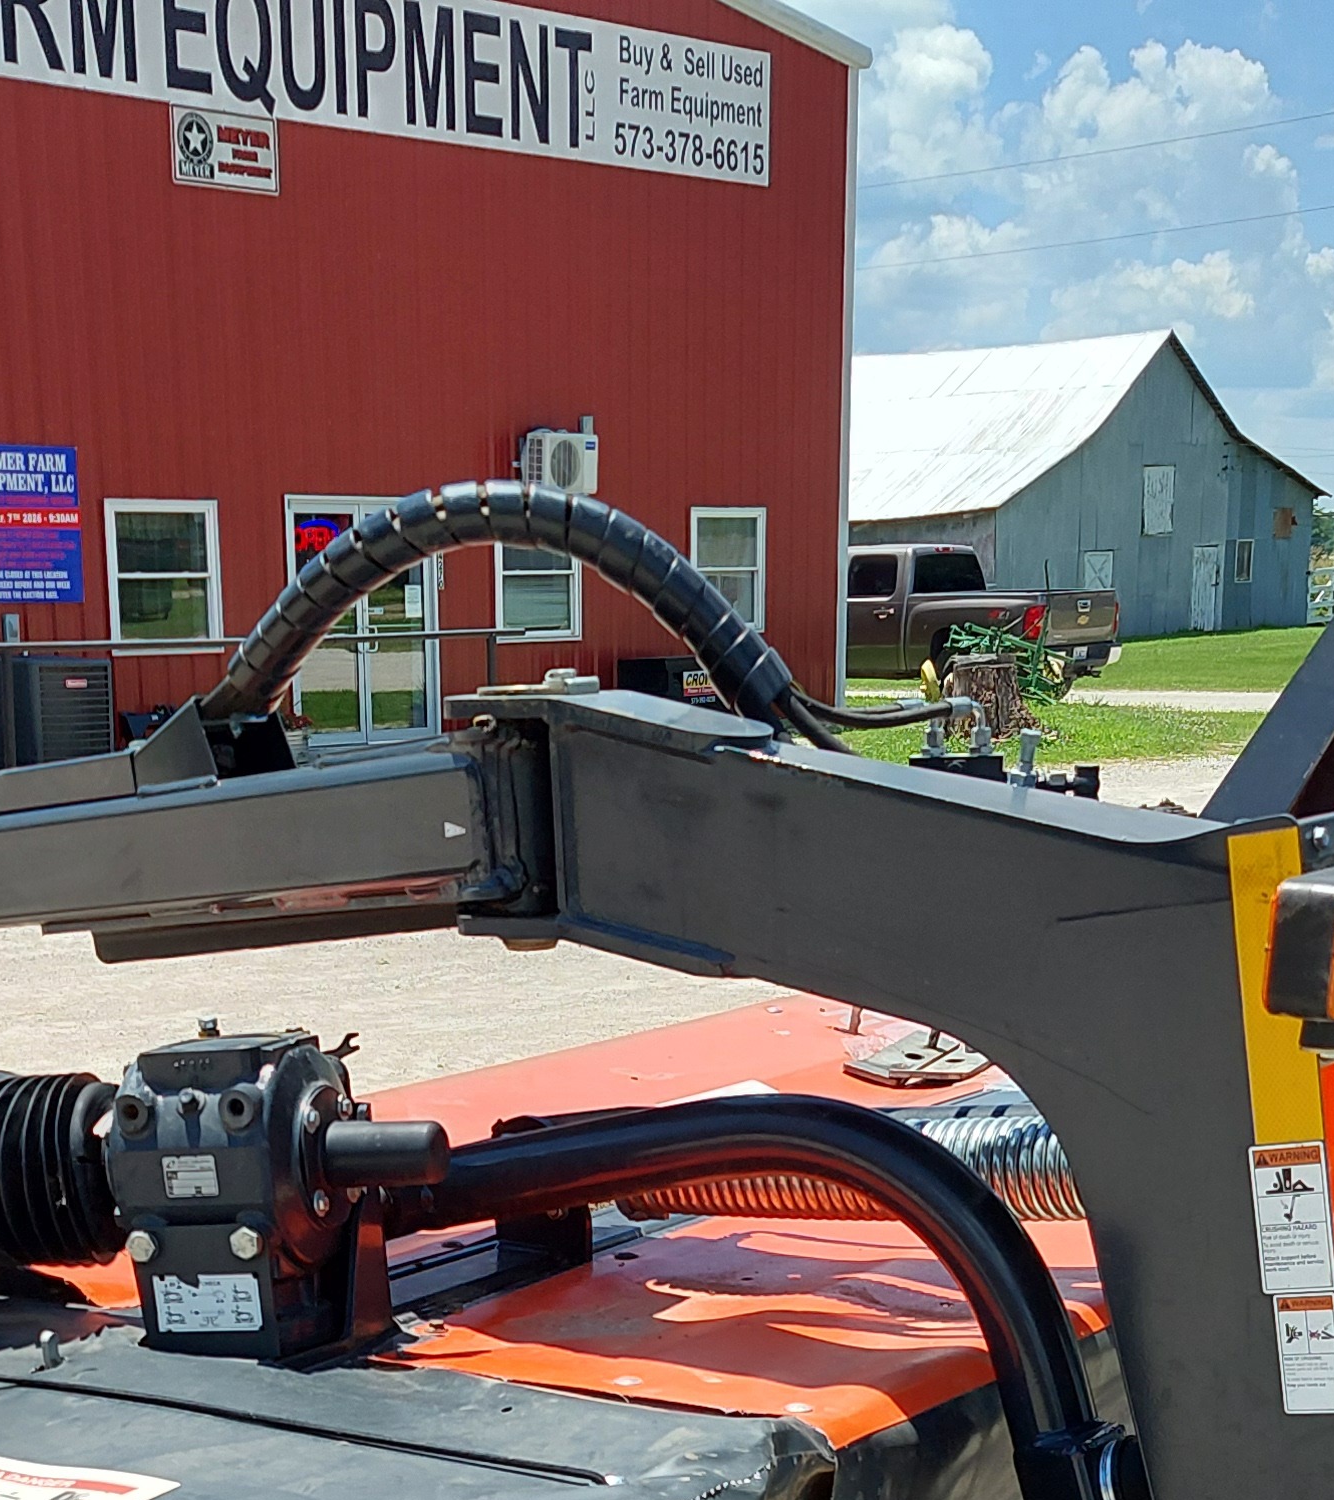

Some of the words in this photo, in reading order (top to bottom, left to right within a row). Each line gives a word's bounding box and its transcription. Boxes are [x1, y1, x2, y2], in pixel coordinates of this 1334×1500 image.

[619, 34, 654, 75] Buy
[660, 43, 673, 73] &
[684, 47, 715, 80] Sell
[721, 54, 764, 88] Used
[163, 0, 592, 149] EQUIPMENT
[619, 77, 664, 112] Farm
[671, 86, 763, 128] Equipment
[614, 122, 765, 176] 573-378-6615
[28, 453, 67, 473] FARM
[51, 474, 75, 494] LLC
[294, 527, 336, 552] OPE
[1268, 1149, 1319, 1163] WARNING
[6, 1471, 77, 1489] DANGER
